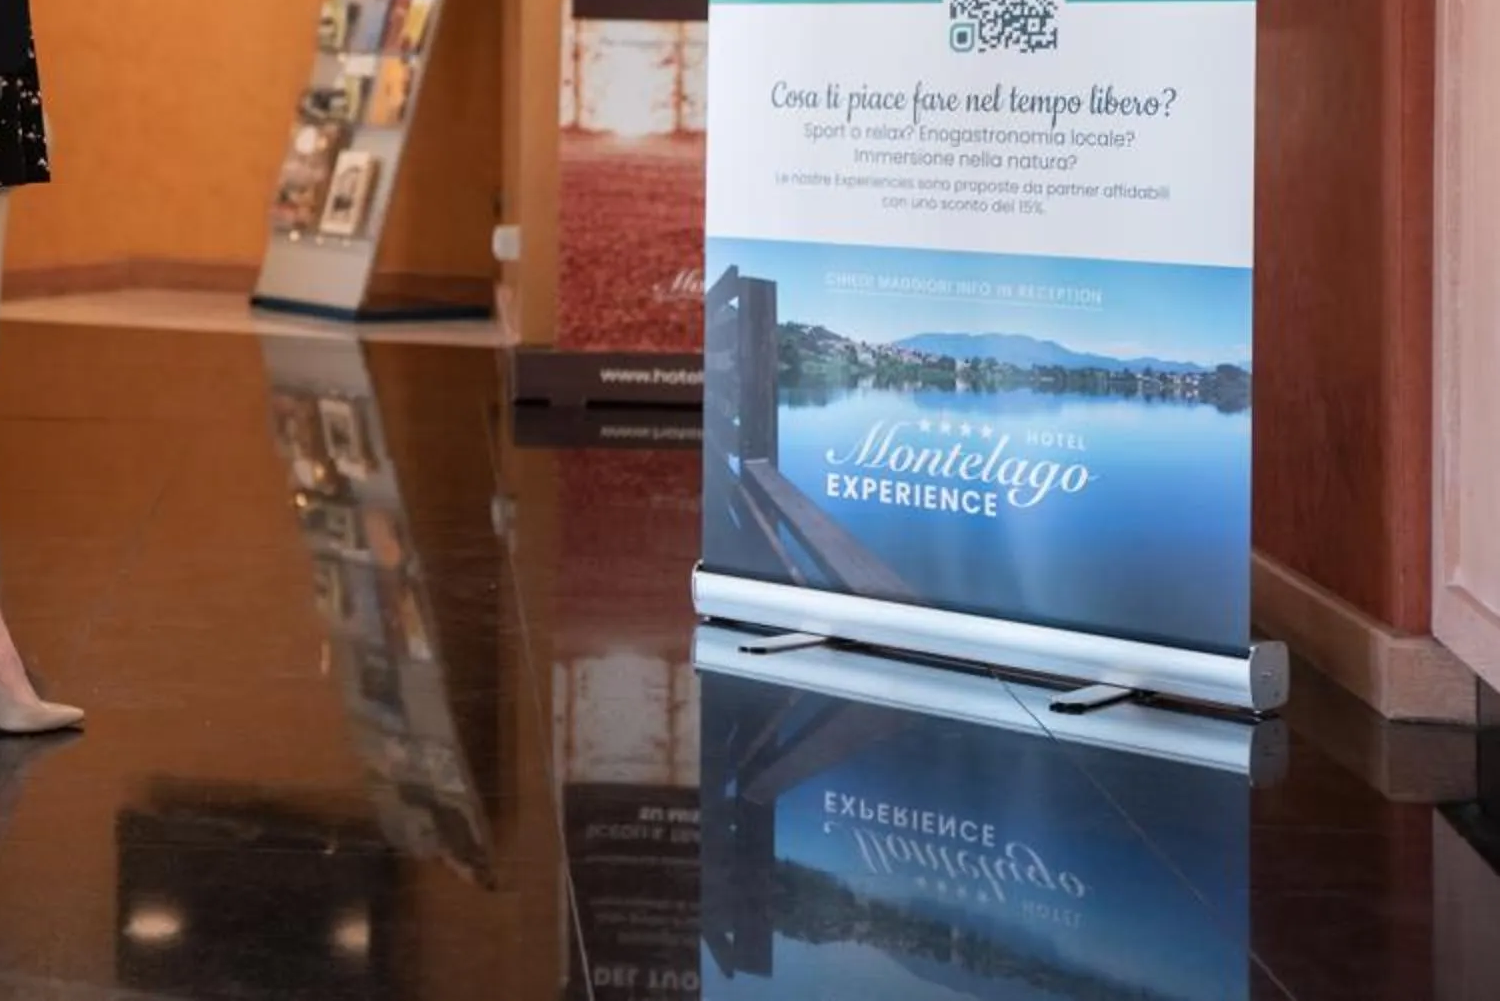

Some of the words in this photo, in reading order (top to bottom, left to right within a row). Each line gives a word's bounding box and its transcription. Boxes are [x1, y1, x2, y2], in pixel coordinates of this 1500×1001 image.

[770, 79, 820, 110] Cosa
[826, 82, 842, 110] ti
[846, 83, 908, 124] piace
[912, 79, 961, 126] fare
[964, 82, 1003, 113] nel
[1008, 85, 1082, 129] tempo
[1088, 83, 1178, 118] libero?
[802, 121, 846, 144] Sport
[849, 126, 862, 140] o
[864, 123, 915, 141] relax?
[918, 124, 1066, 148] Enogastronomia
[1070, 127, 1136, 148] locale?
[853, 148, 956, 167] Immersione
[958, 150, 1003, 168] nella
[1007, 154, 1078, 171] natura?
[917, 178, 952, 192] sono
[953, 178, 1019, 196] proposte
[1022, 180, 1044, 195] da
[1046, 182, 1100, 199] partner
[1102, 184, 1172, 201] affidabili
[881, 196, 908, 209] con
[940, 198, 989, 213] sconto
[1025, 429, 1088, 452] HOTEL
[825, 419, 1100, 509] Montelago
[826, 472, 999, 518] EXPERIENCE
